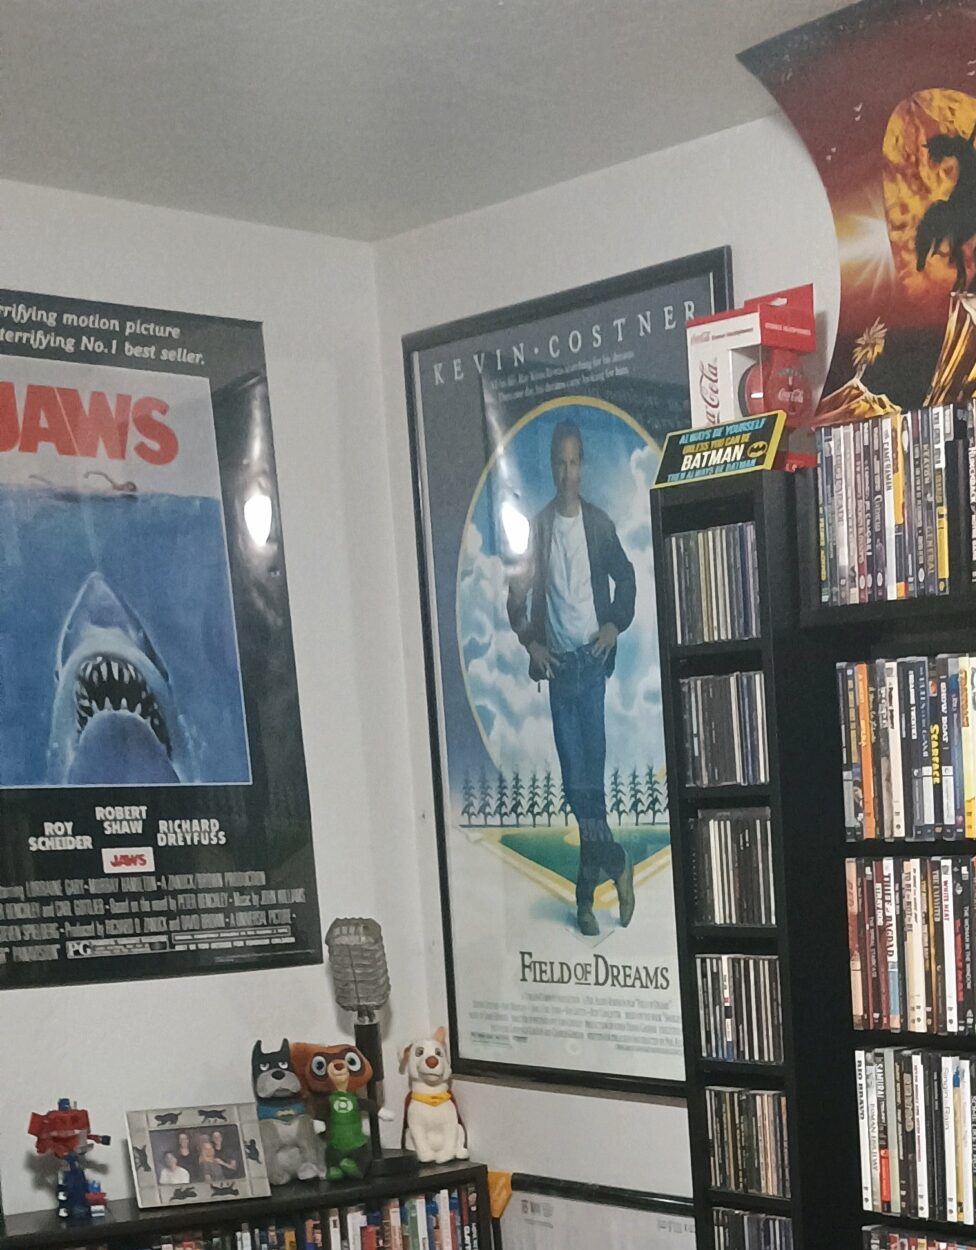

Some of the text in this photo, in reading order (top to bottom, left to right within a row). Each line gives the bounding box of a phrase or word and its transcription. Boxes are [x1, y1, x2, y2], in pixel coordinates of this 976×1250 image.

[63, 312, 120, 332] motion
[125, 321, 181, 340] picture
[124, 340, 156, 360] best
[160, 345, 206, 366] seller.
[433, 345, 525, 386] KEVIN
[548, 301, 695, 359] COSTNER
[0, 381, 179, 466] JAWS
[681, 444, 745, 471] BATMAN
[930, 724, 939, 784] SCARFACE
[95, 806, 147, 821] ROBERT
[44, 821, 73, 836] ROY
[103, 820, 143, 834] SHAW
[158, 819, 219, 834] RICHARD
[28, 836, 93, 851] SCHEIDER
[157, 832, 226, 847] DREYFUSS
[110, 854, 147, 867] JAWS
[884, 873, 893, 957] THIEF BAGDAD
[68, 943, 91, 956] PG
[876, 1064, 884, 1098] SAMURAI
